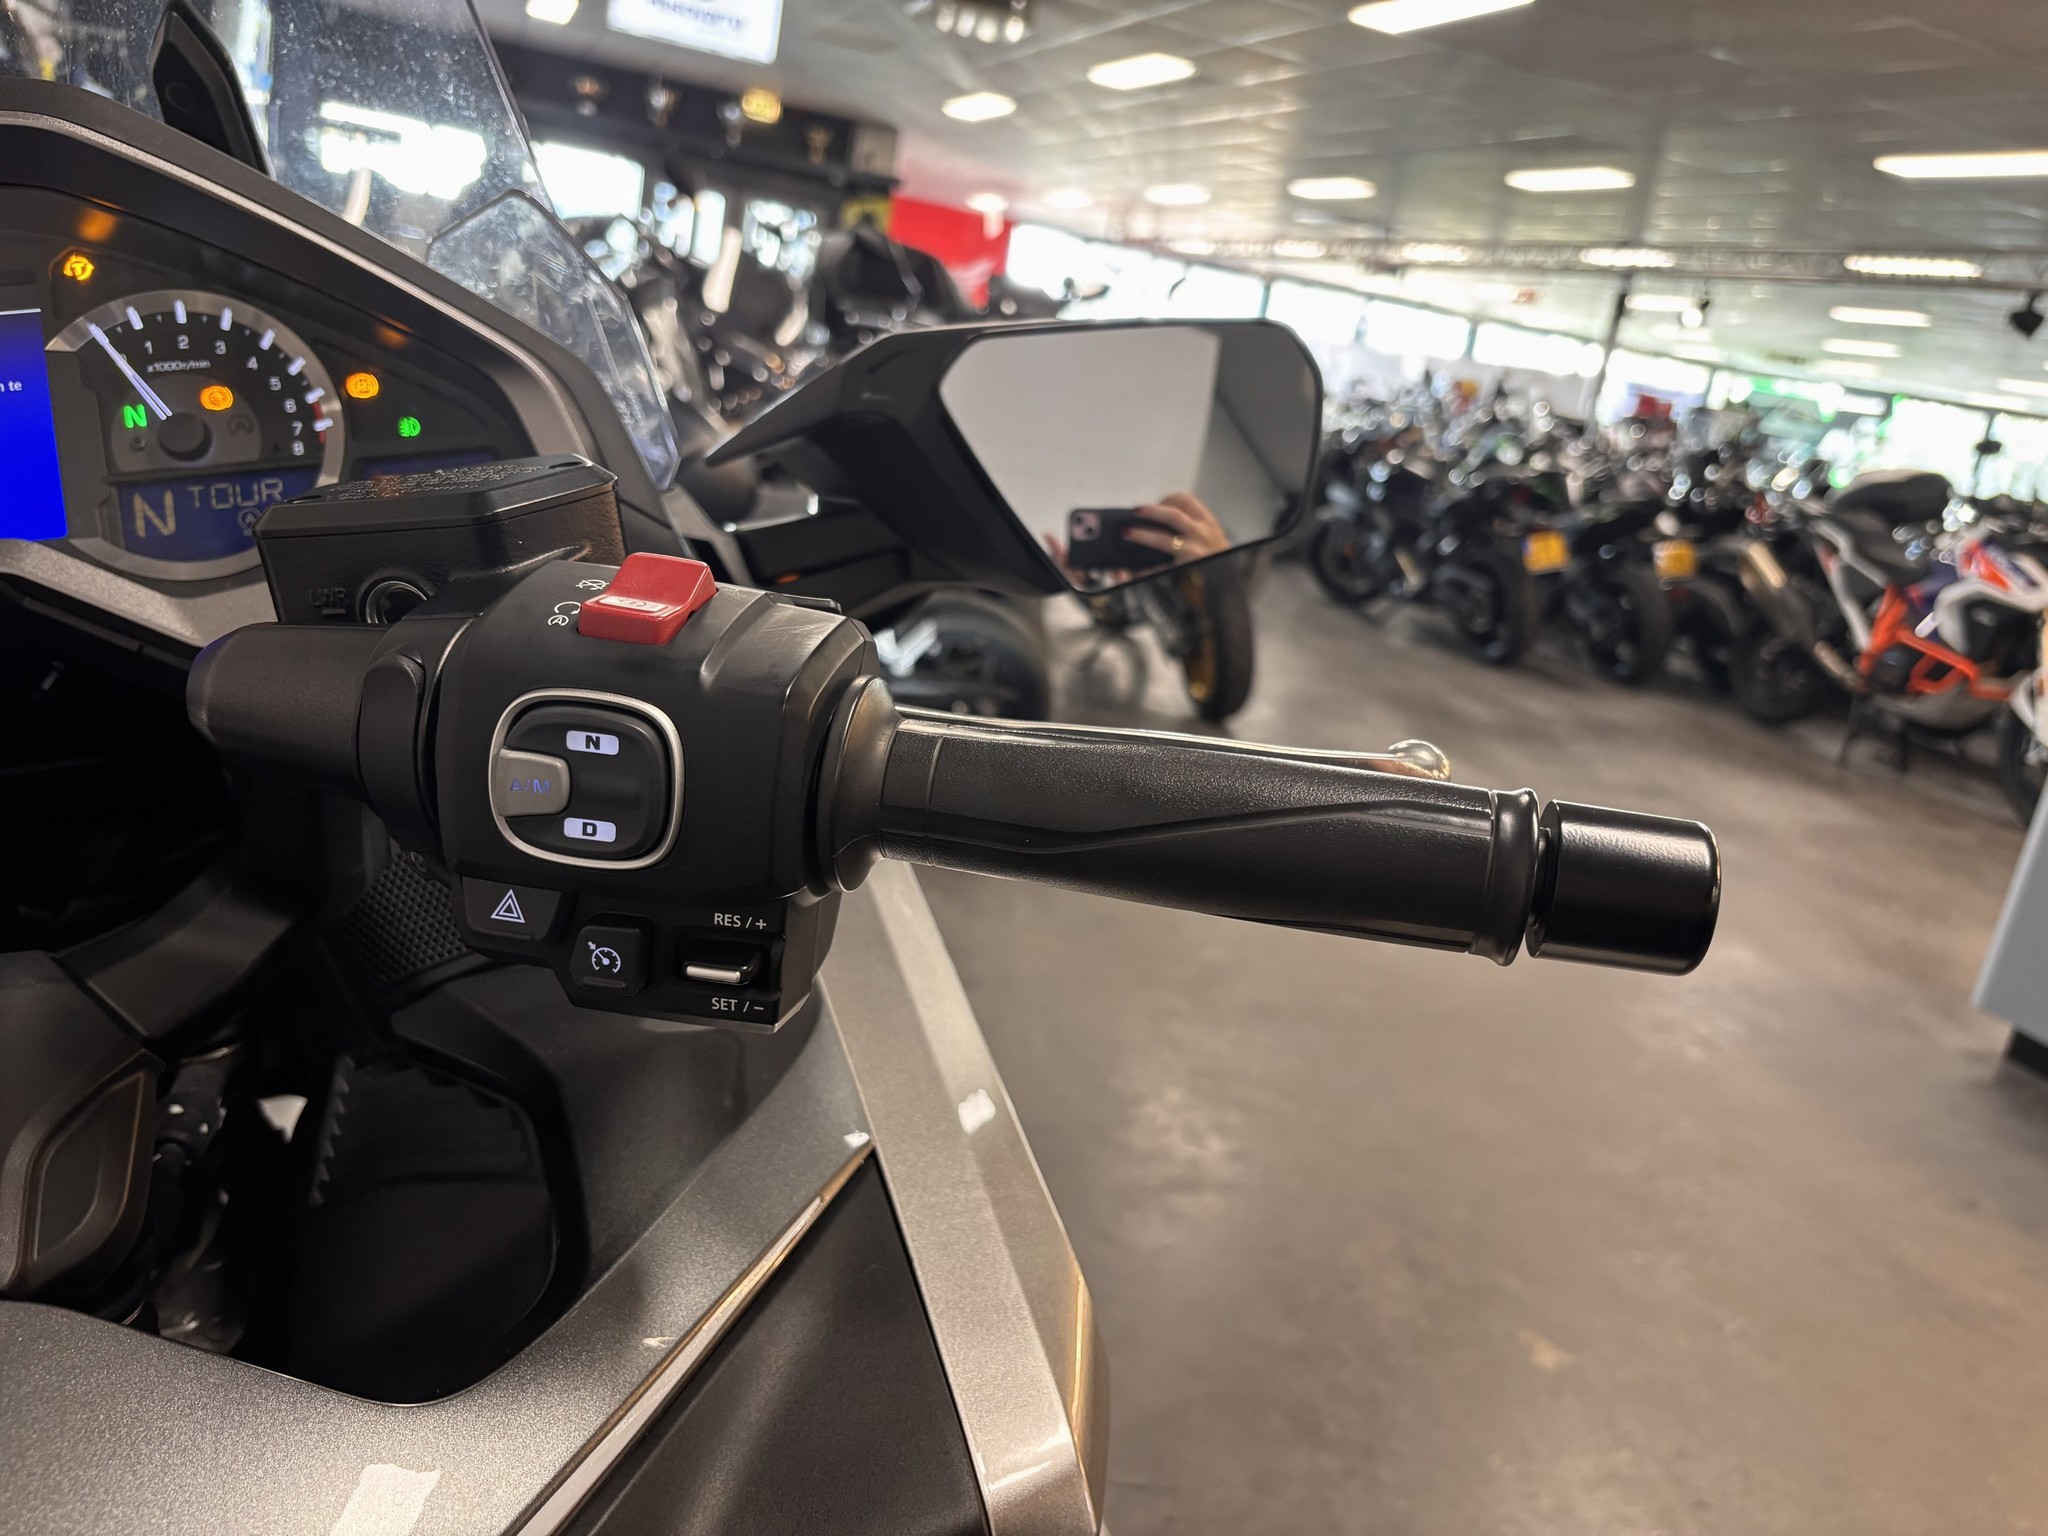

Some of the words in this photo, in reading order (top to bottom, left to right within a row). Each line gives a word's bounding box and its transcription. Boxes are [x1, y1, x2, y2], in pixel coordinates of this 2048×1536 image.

[144, 340, 153, 355] 1
[177, 334, 189, 350] 2
[214, 340, 227, 355] 3
[246, 355, 258, 371] 4
[8, 380, 23, 392] te
[269, 375, 282, 392] 5
[284, 398, 297, 414] 6
[122, 404, 148, 429] N
[291, 421, 303, 437] 7
[292, 440, 305, 456] 8
[187, 477, 283, 509] TOUR
[133, 488, 177, 539] N
[585, 734, 601, 751] N
[509, 777, 551, 794] A/M
[582, 821, 598, 838] D
[713, 912, 742, 928] RES
[711, 997, 739, 1012] SET
